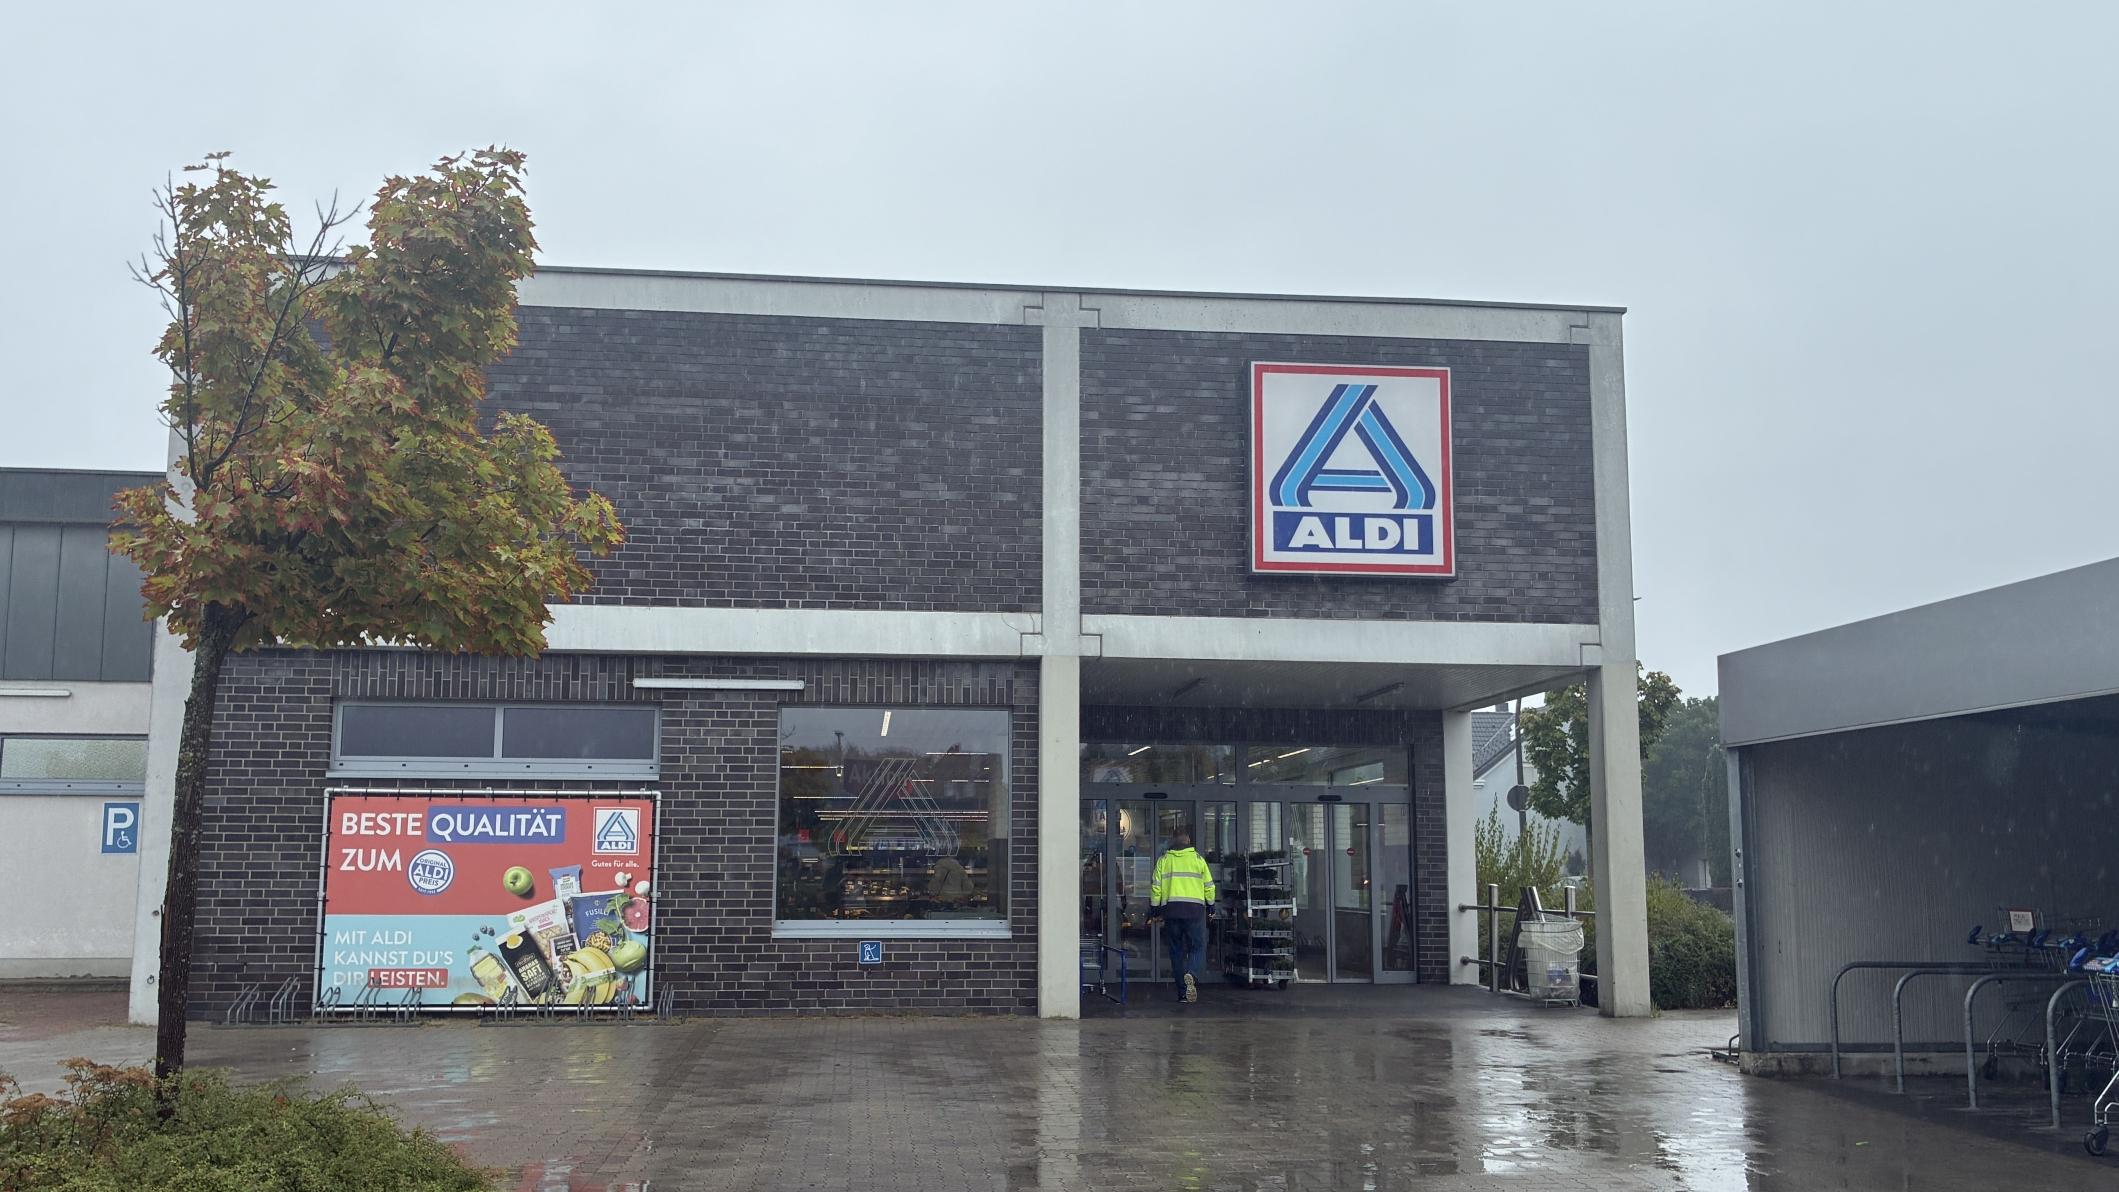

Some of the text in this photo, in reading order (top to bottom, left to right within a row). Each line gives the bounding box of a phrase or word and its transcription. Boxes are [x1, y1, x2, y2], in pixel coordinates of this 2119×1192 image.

[1288, 516, 1419, 550] ALDI
[106, 808, 134, 846] P
[342, 809, 561, 841] BESTE QUALITÄT
[601, 842, 631, 850] ALDI
[340, 849, 402, 871] ZUM
[420, 858, 447, 868] ORIGINAL
[592, 860, 612, 868] Gutes
[614, 860, 624, 868] für
[414, 864, 449, 880] ALDI
[418, 877, 439, 886] PREIS
[335, 930, 412, 945] MIT ALDI
[334, 951, 453, 965] KANNST DU’S
[333, 971, 364, 985] DIR
[521, 964, 542, 981] SAFT
